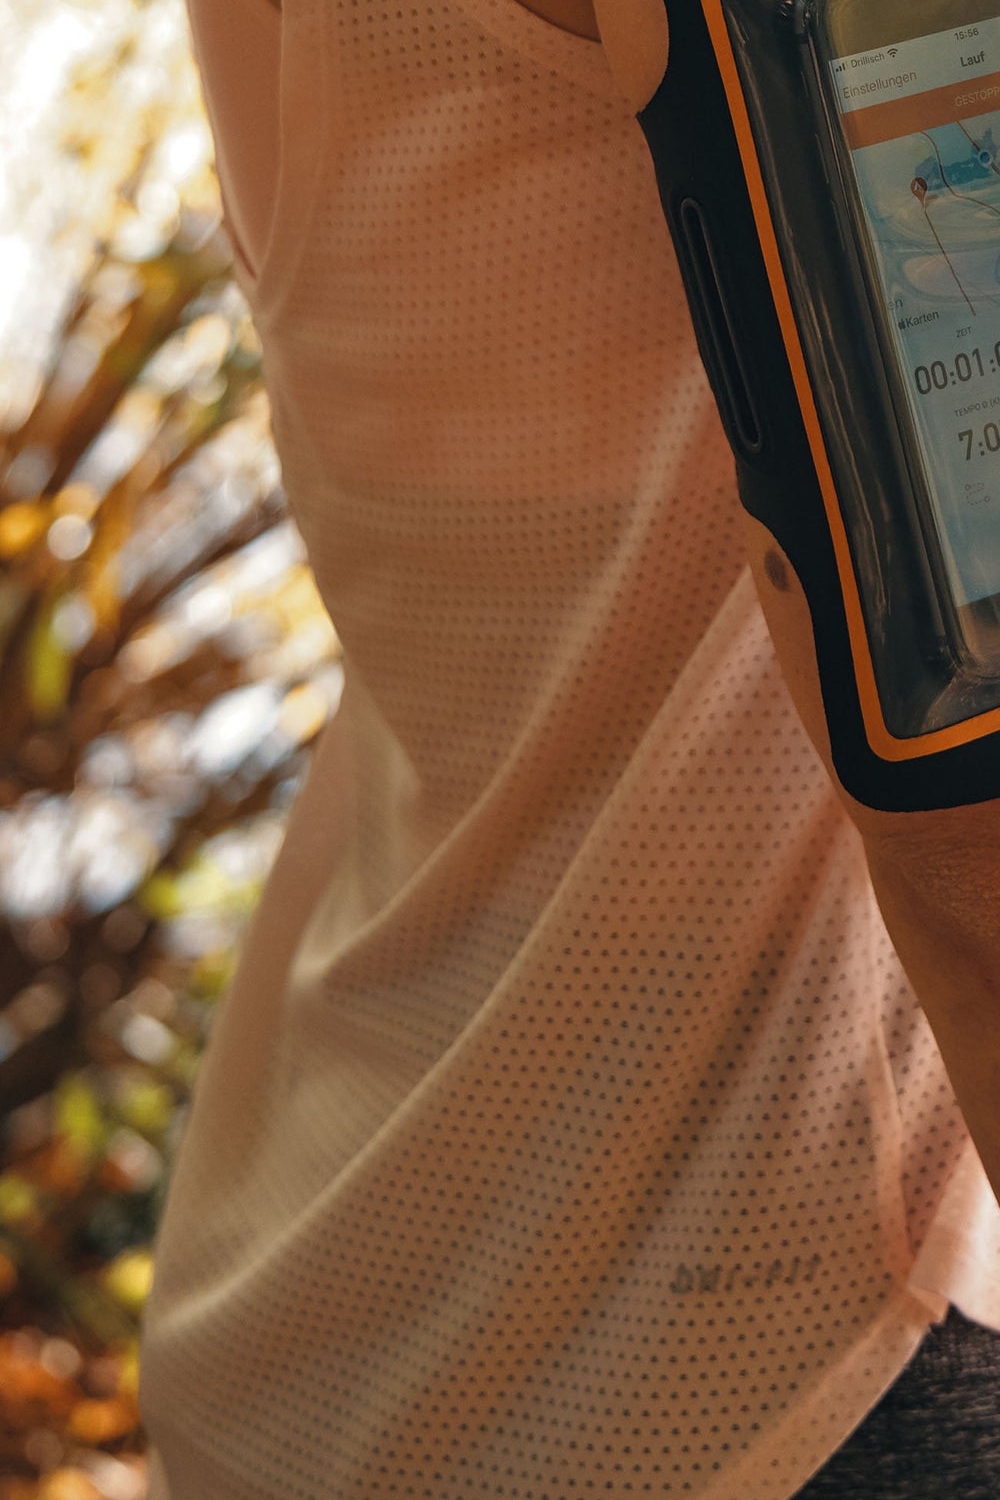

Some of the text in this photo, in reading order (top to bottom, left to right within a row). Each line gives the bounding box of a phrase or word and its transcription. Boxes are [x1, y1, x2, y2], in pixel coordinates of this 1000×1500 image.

[954, 26, 980, 42] 15:56
[850, 52, 886, 69] Drillisch
[960, 50, 987, 68] Lauf
[843, 70, 918, 99] Einstellungen
[955, 326, 972, 339] ZEIT
[953, 403, 982, 418] TEMPO
